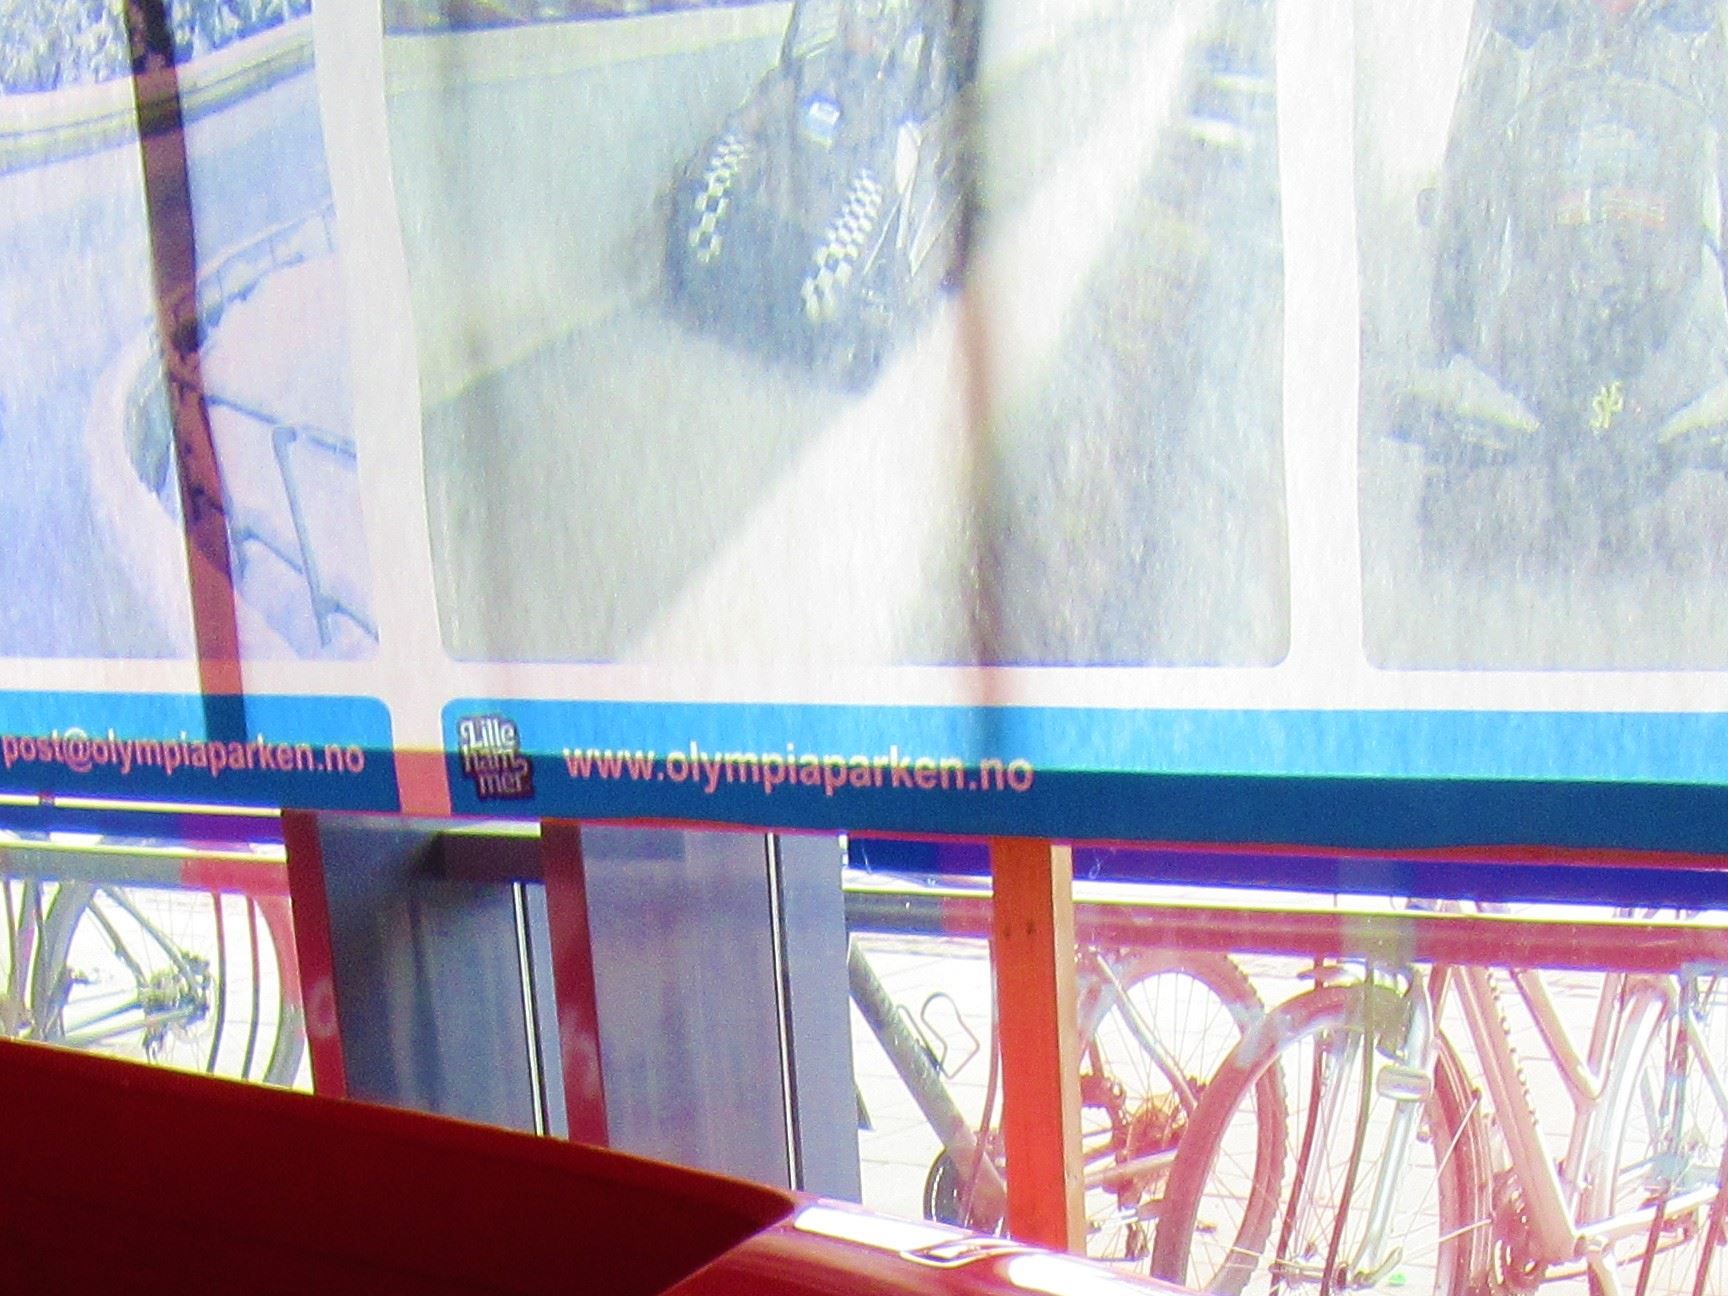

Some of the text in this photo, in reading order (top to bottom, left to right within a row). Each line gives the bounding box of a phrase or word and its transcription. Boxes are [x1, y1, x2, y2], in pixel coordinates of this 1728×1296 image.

[0, 726, 366, 778] post@olympiaparken.no
[459, 717, 516, 749] Lille
[562, 739, 1035, 798] www.olympiaparken.no
